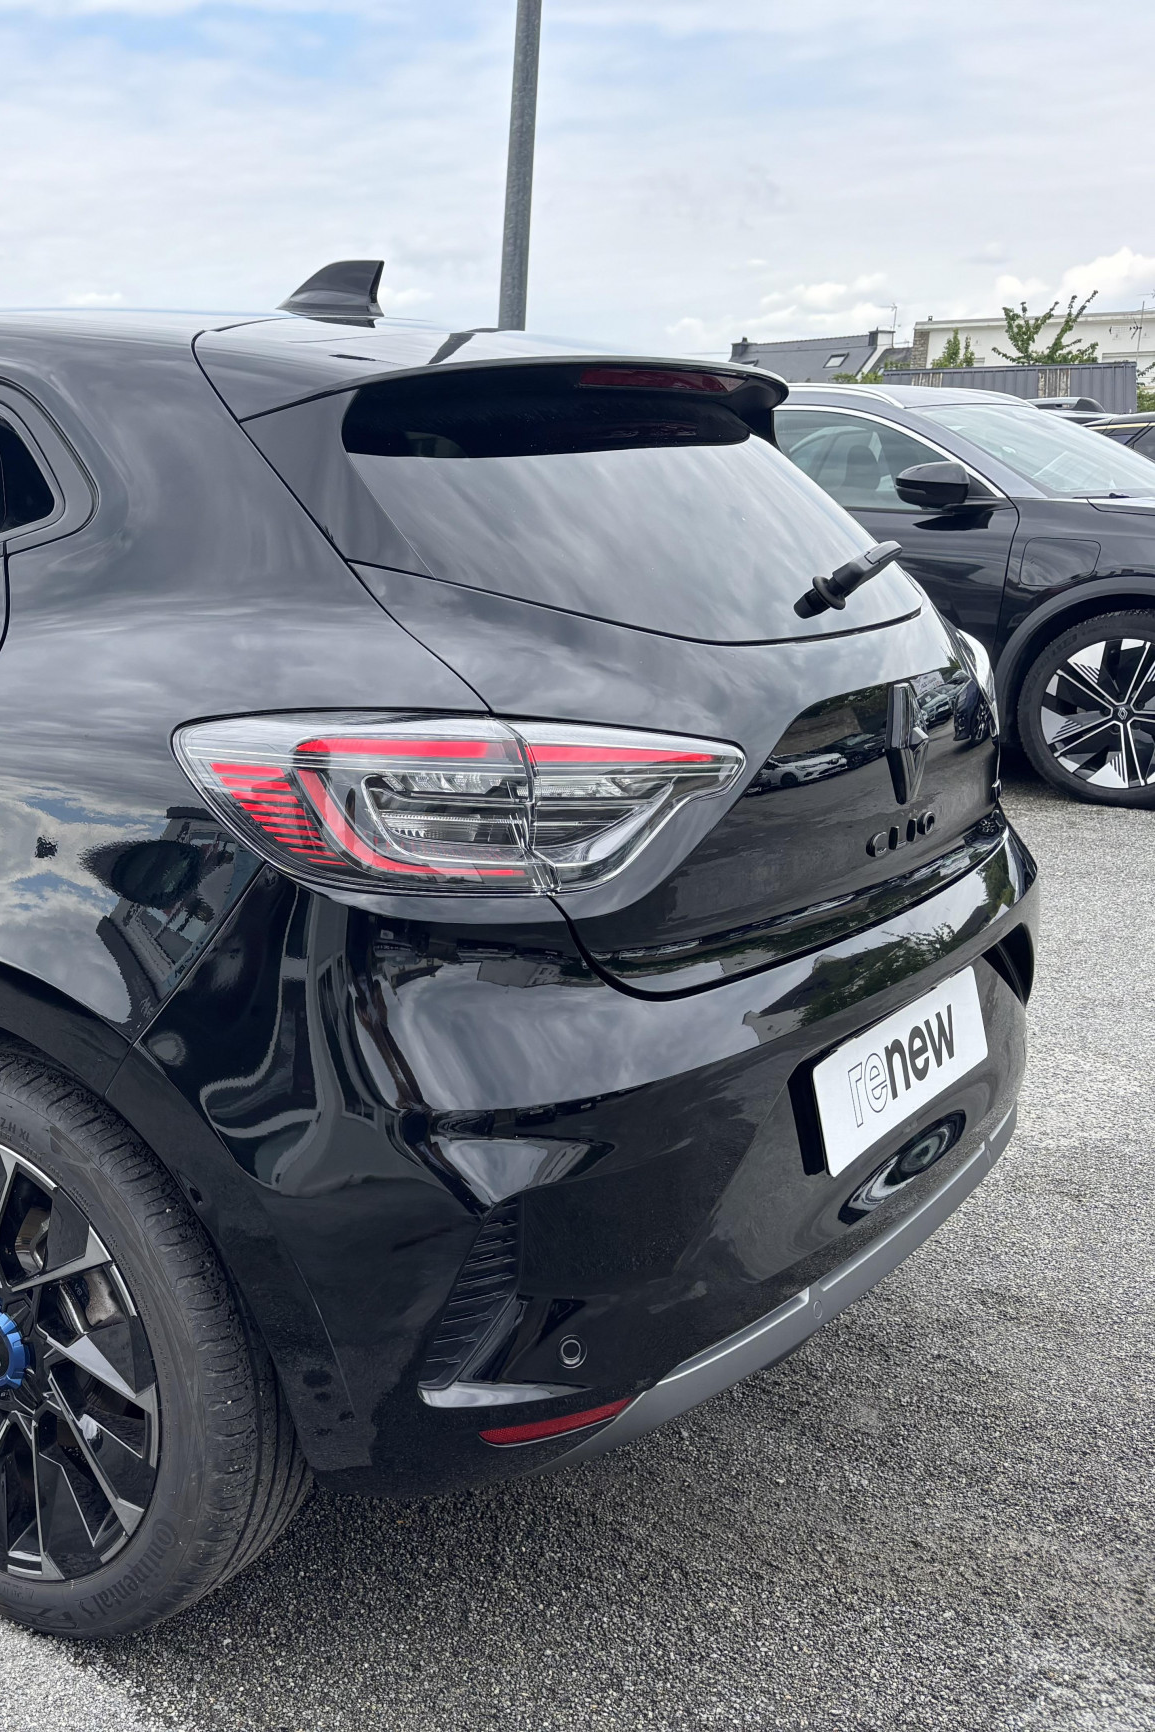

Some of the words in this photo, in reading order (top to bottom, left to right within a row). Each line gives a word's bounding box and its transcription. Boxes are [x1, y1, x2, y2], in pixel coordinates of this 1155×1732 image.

[865, 811, 936, 857] CLIO
[847, 1003, 955, 1128] renew
[89, 1518, 178, 1618] Continental
